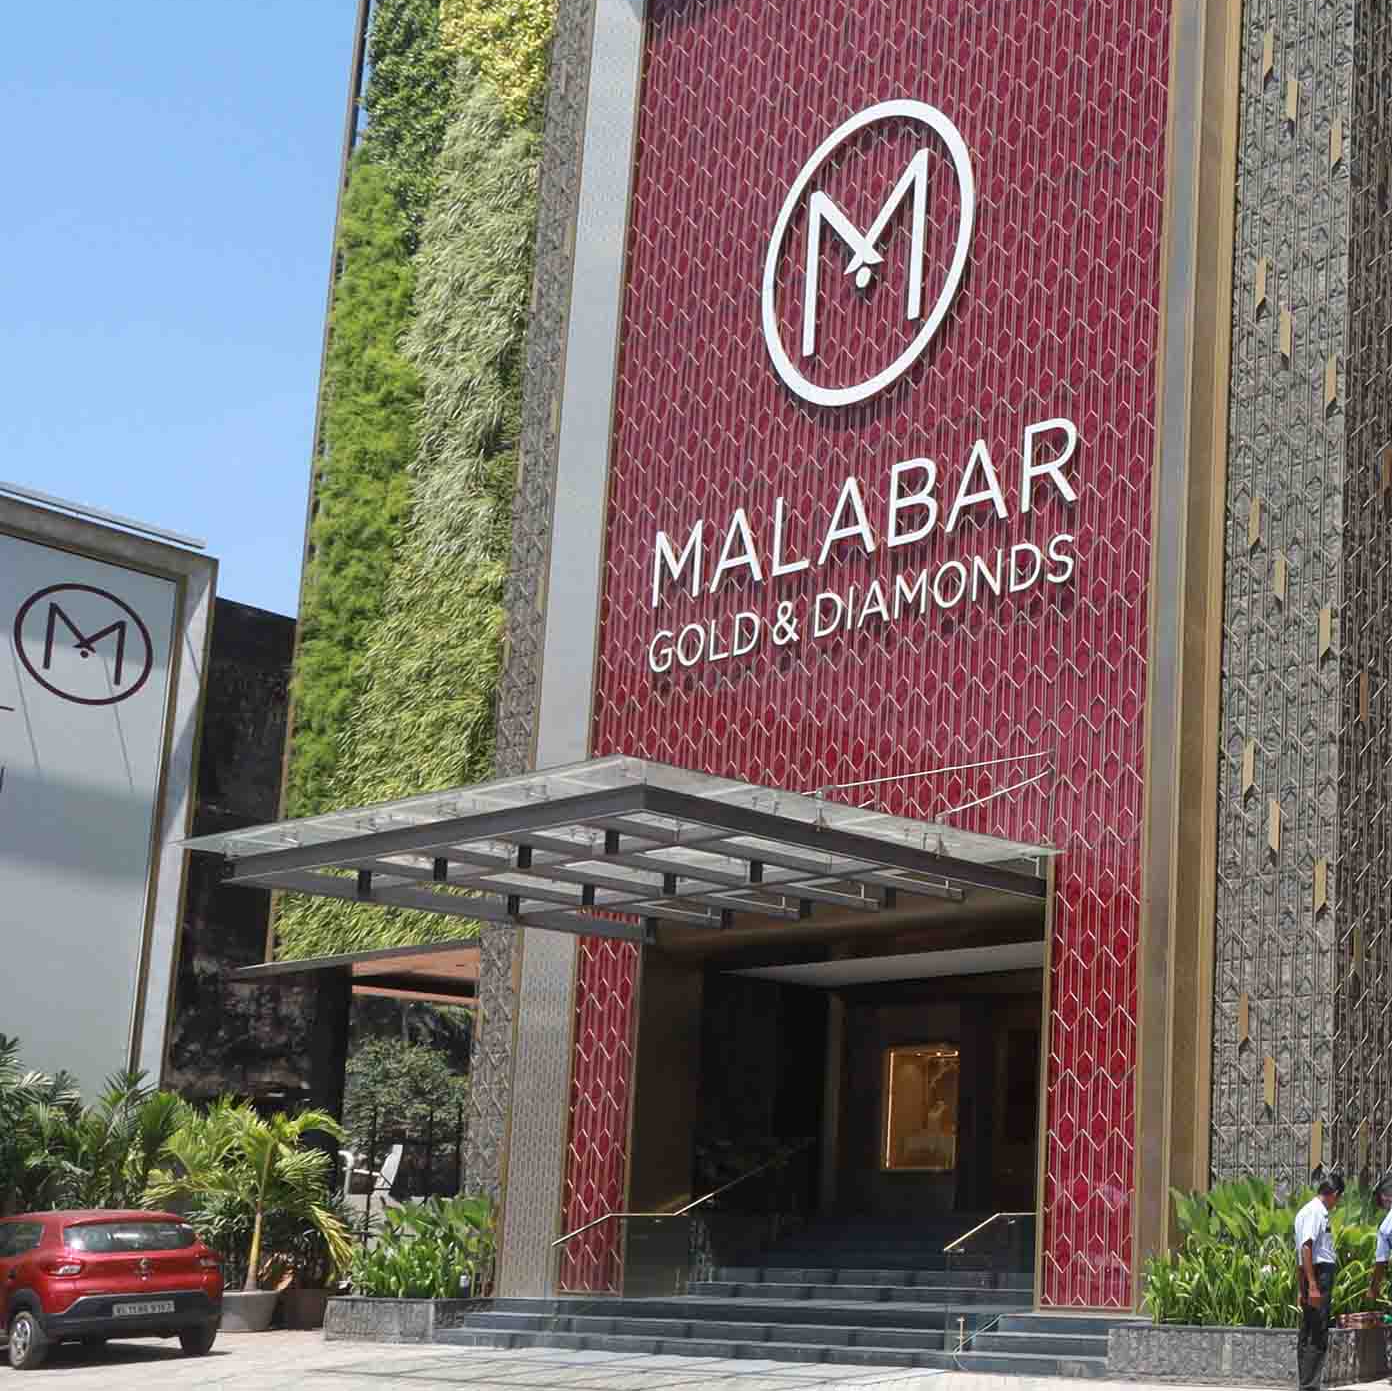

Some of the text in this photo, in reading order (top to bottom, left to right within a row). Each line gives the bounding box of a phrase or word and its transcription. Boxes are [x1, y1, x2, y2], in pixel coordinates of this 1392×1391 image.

[650, 417, 1079, 608] MALABAR
[648, 533, 1076, 673] GOLD & DIAMONDS
